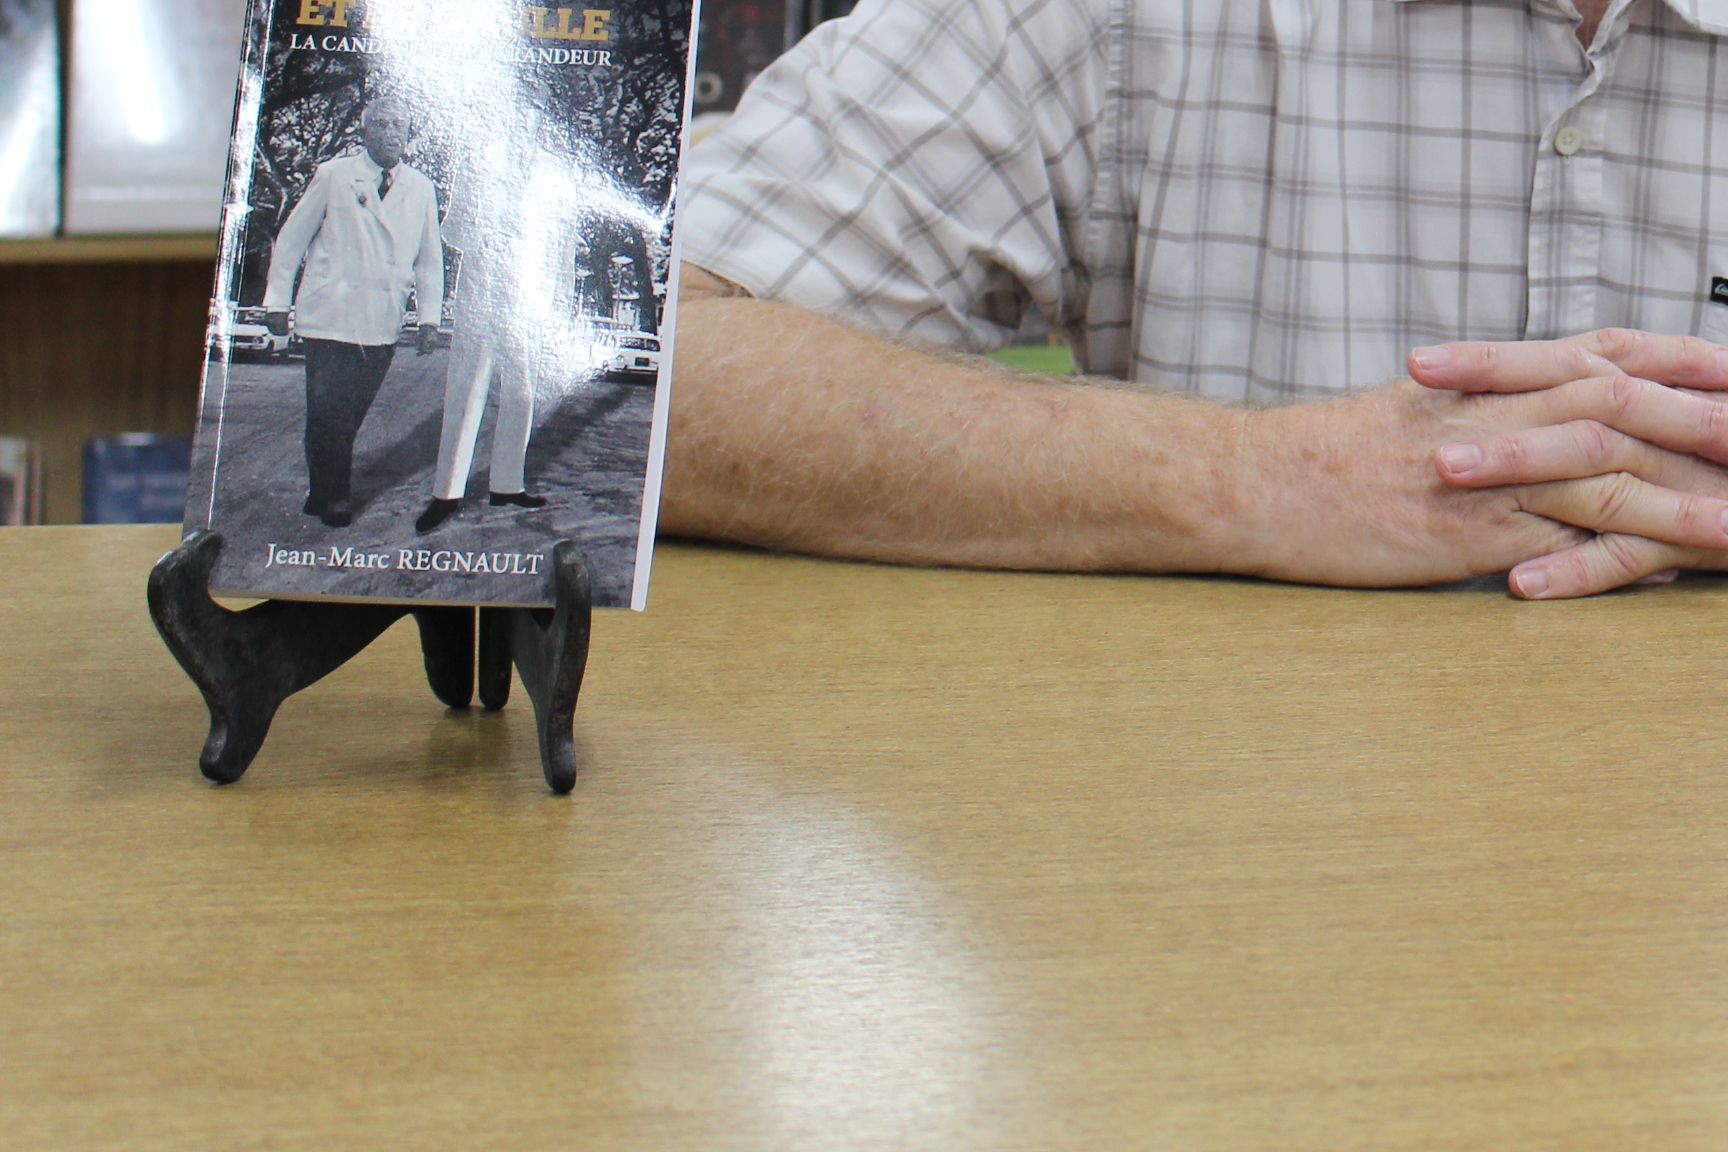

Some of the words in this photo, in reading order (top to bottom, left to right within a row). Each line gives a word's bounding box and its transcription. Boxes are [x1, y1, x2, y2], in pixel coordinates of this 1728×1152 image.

[289, 33, 316, 51] LA
[491, 45, 612, 67] GRANDEUR
[265, 543, 390, 568] Jean-Marc
[396, 549, 544, 575] REGNAULT
